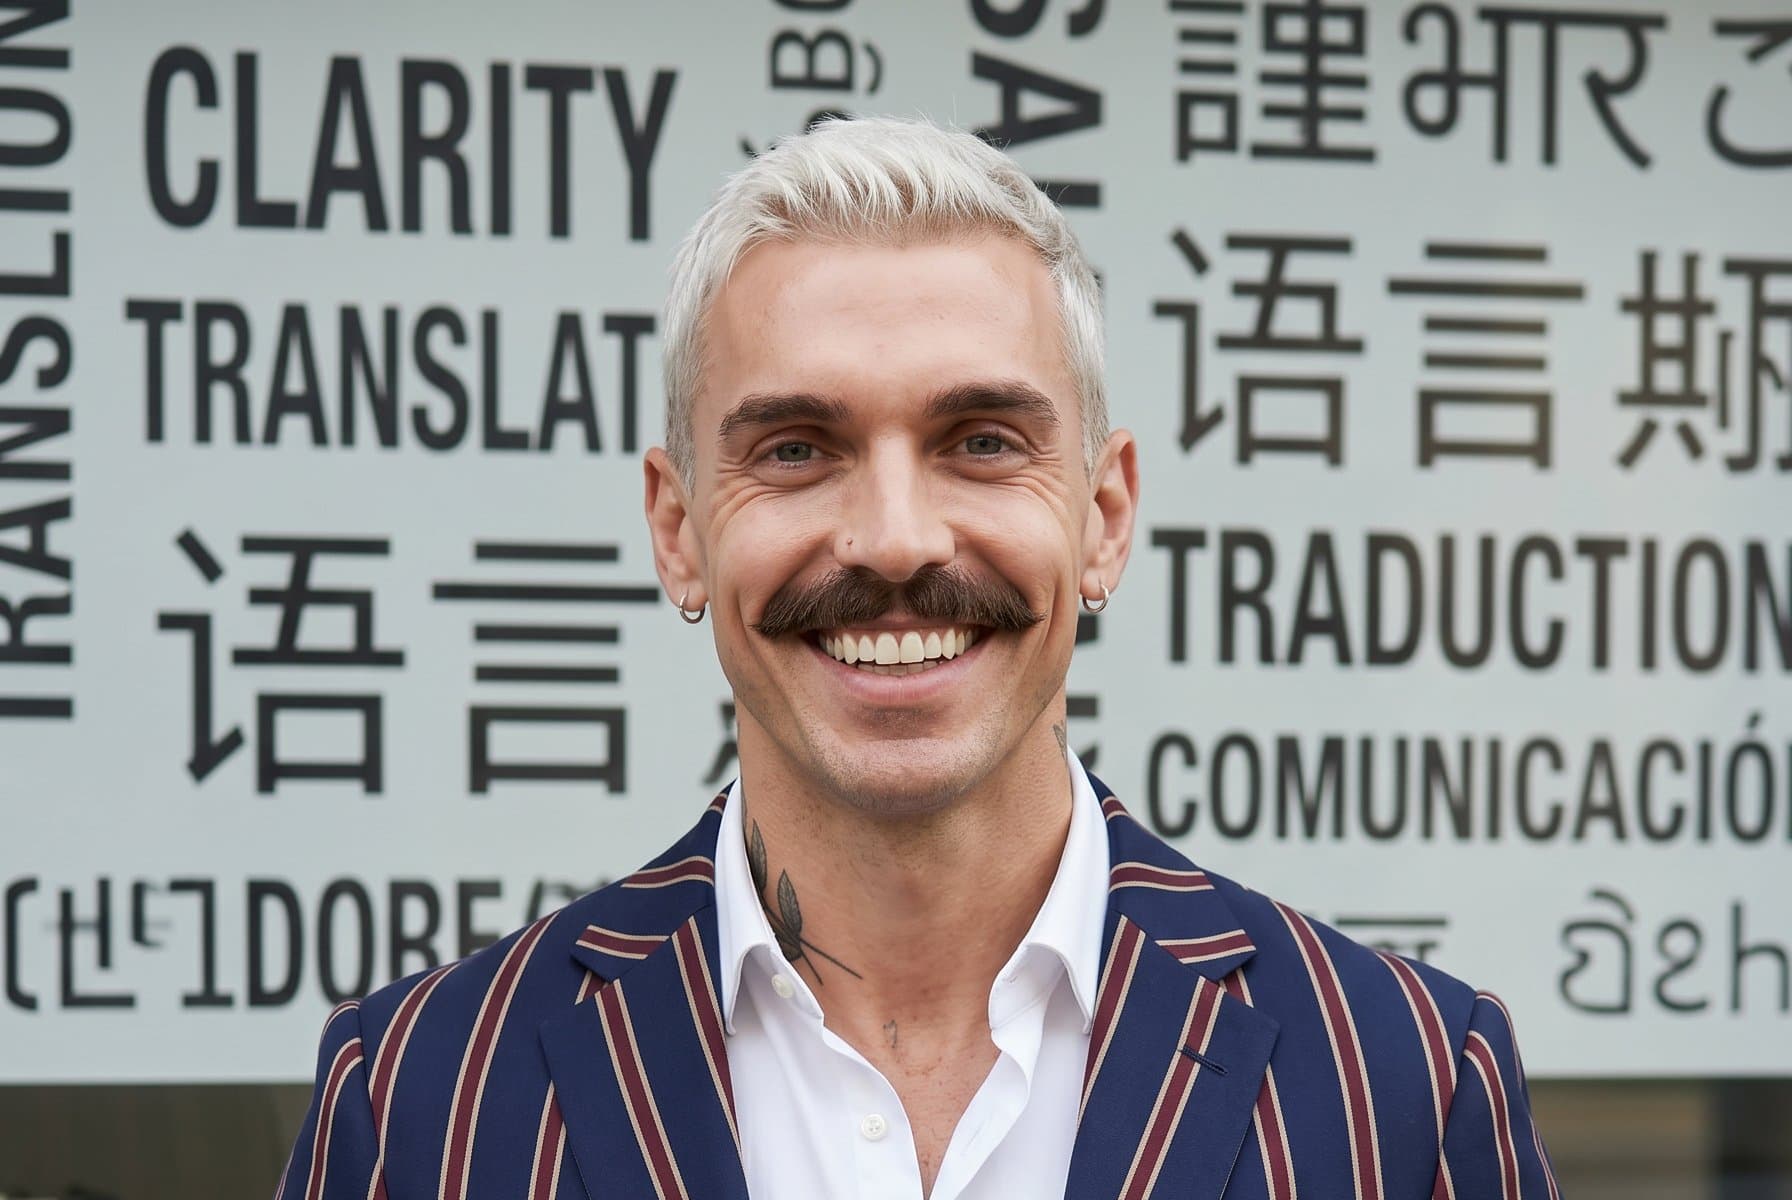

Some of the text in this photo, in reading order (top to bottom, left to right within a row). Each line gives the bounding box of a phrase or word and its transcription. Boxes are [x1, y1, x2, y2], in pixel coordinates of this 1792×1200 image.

[144, 46, 680, 241] CLARITY
[125, 298, 656, 454] TRANSLAT
[1150, 528, 1792, 674] TRADUCTION
[1147, 712, 1792, 845] COMUNICACIÓ
